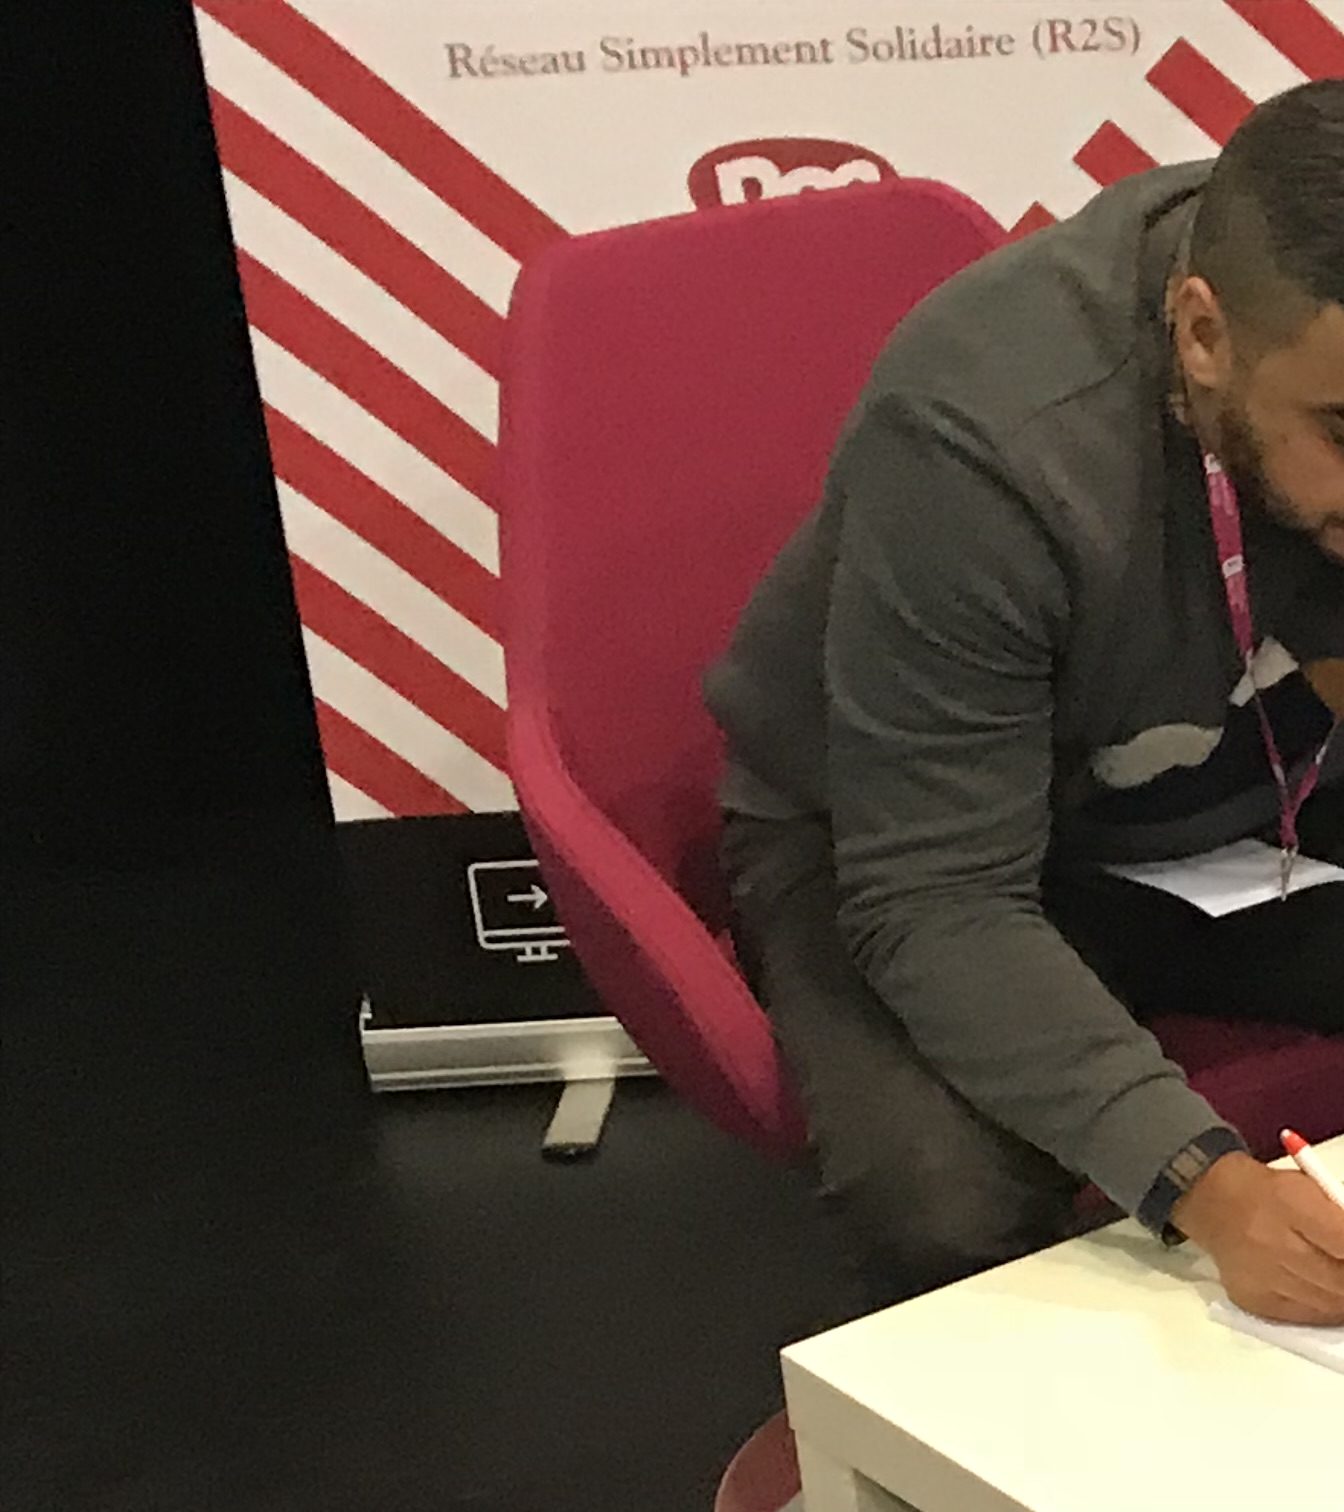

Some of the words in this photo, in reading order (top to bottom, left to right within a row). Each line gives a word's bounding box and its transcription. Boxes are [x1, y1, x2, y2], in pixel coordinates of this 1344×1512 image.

[444, 42, 587, 80] Réseau
[599, 31, 835, 78] Simplement
[845, 22, 1016, 62] Solidaire
[1032, 16, 1141, 57] (R2S)
